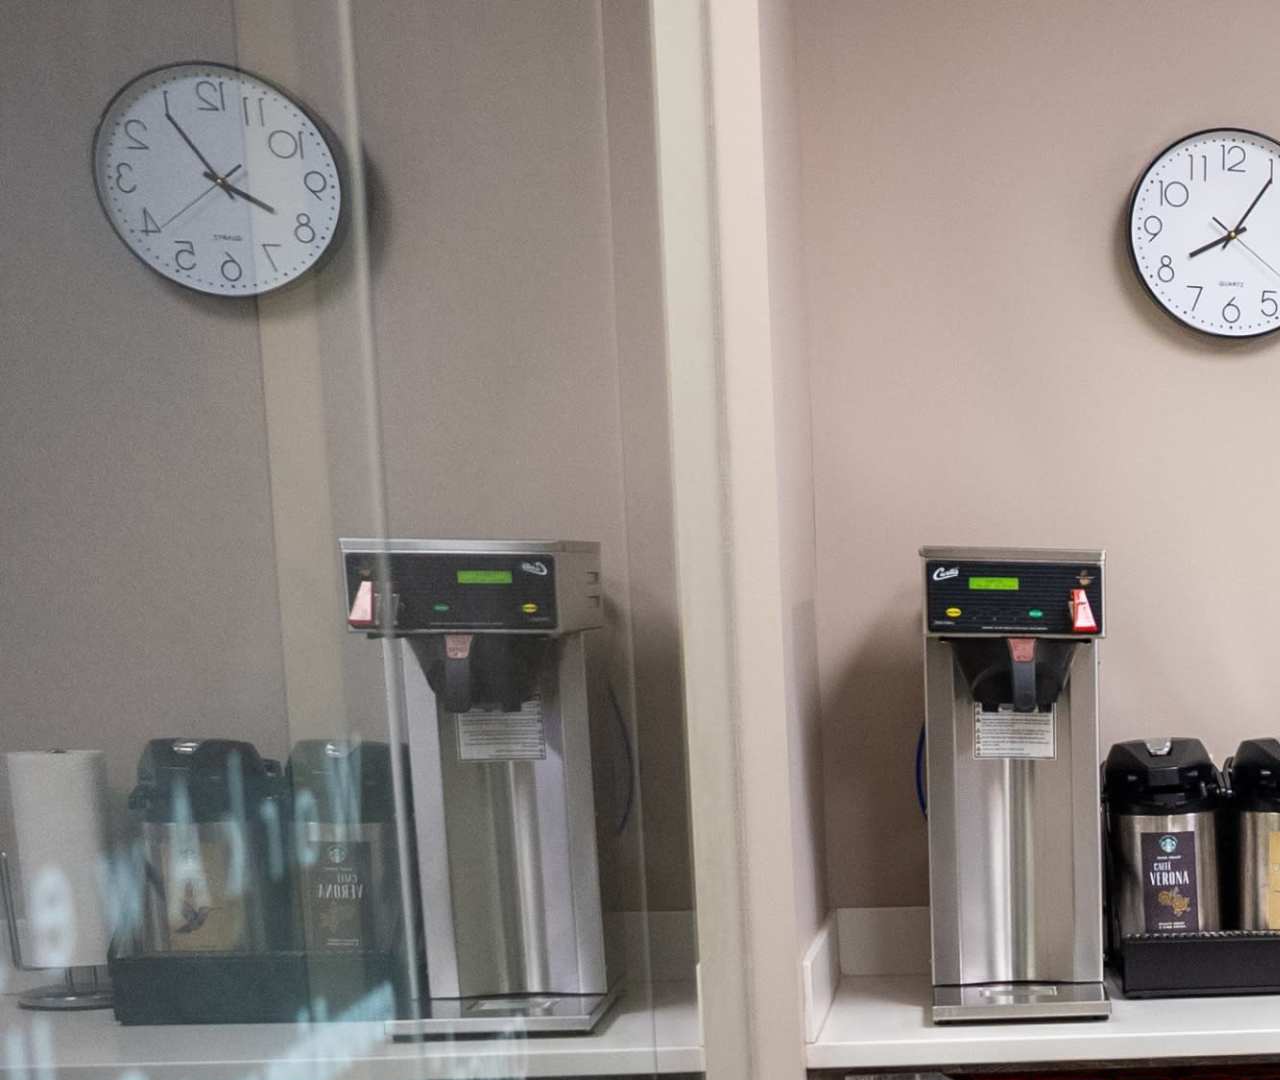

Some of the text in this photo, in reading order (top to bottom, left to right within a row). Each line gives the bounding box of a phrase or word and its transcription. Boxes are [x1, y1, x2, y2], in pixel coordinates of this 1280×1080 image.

[1188, 154, 1207, 182] 11
[1220, 144, 1246, 173] 12
[1159, 180, 1190, 208] 10
[1144, 216, 1163, 243] 9
[1157, 255, 1175, 283] 8
[1187, 285, 1204, 312] 7
[1222, 297, 1241, 324] 6
[1261, 290, 1279, 317] 5
[1149, 870, 1190, 886] VERONA
